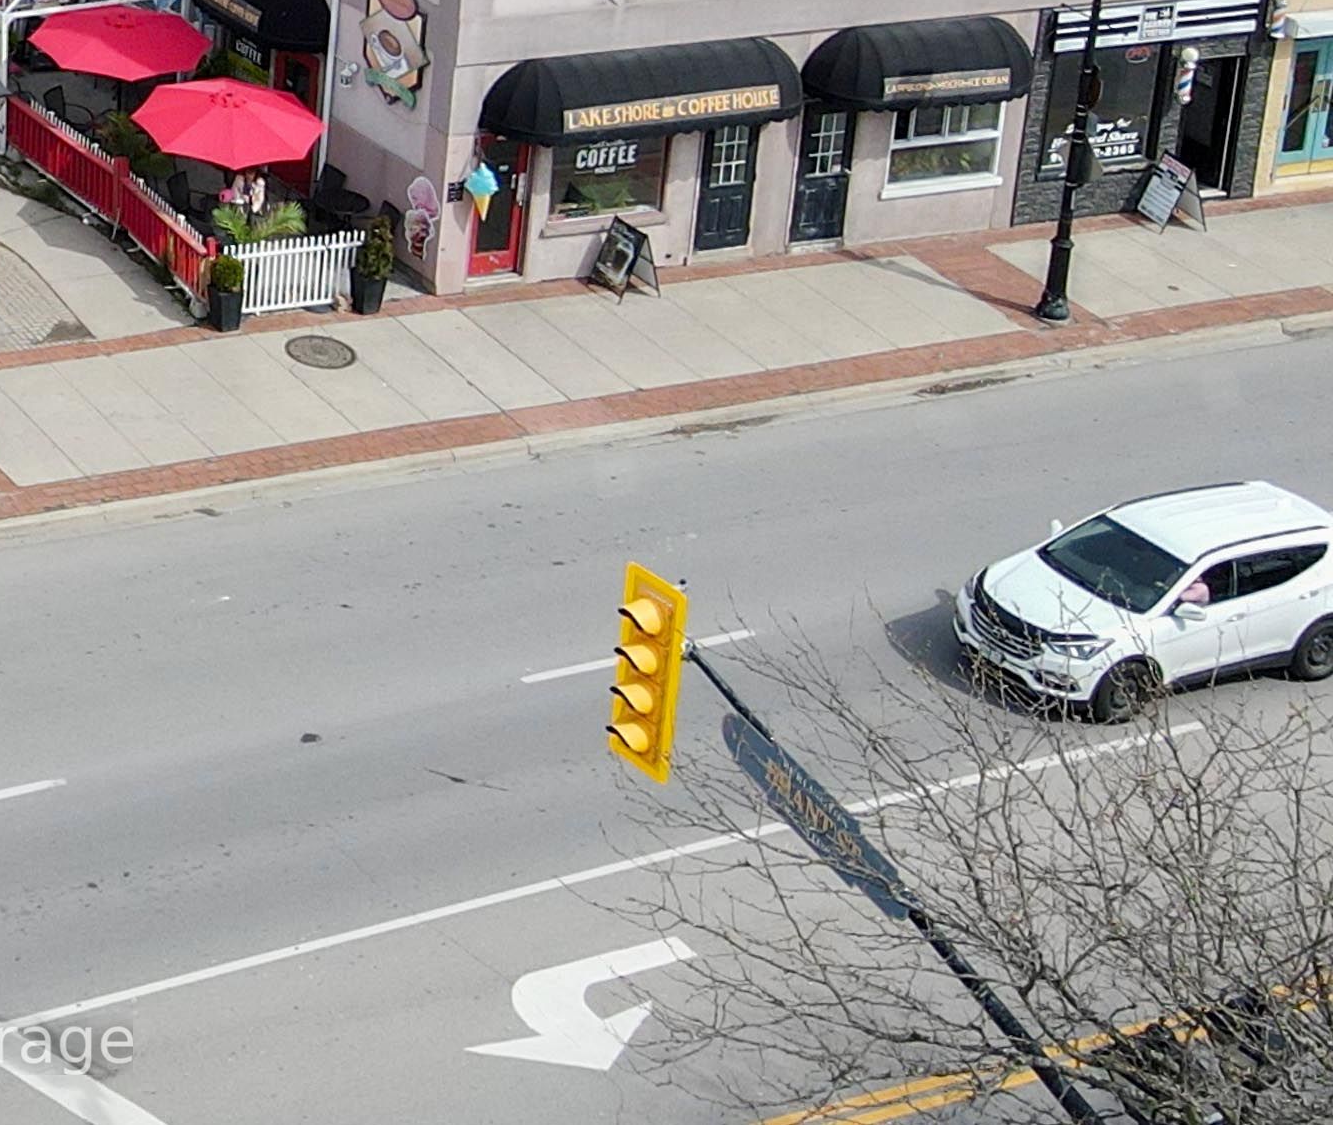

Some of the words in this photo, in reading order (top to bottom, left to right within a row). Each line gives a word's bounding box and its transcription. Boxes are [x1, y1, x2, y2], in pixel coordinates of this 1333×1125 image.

[567, 102, 662, 129] LAKESHORE
[677, 92, 731, 116] COFFEE
[732, 88, 780, 110] HOUSE
[575, 143, 638, 169] COFFEE
